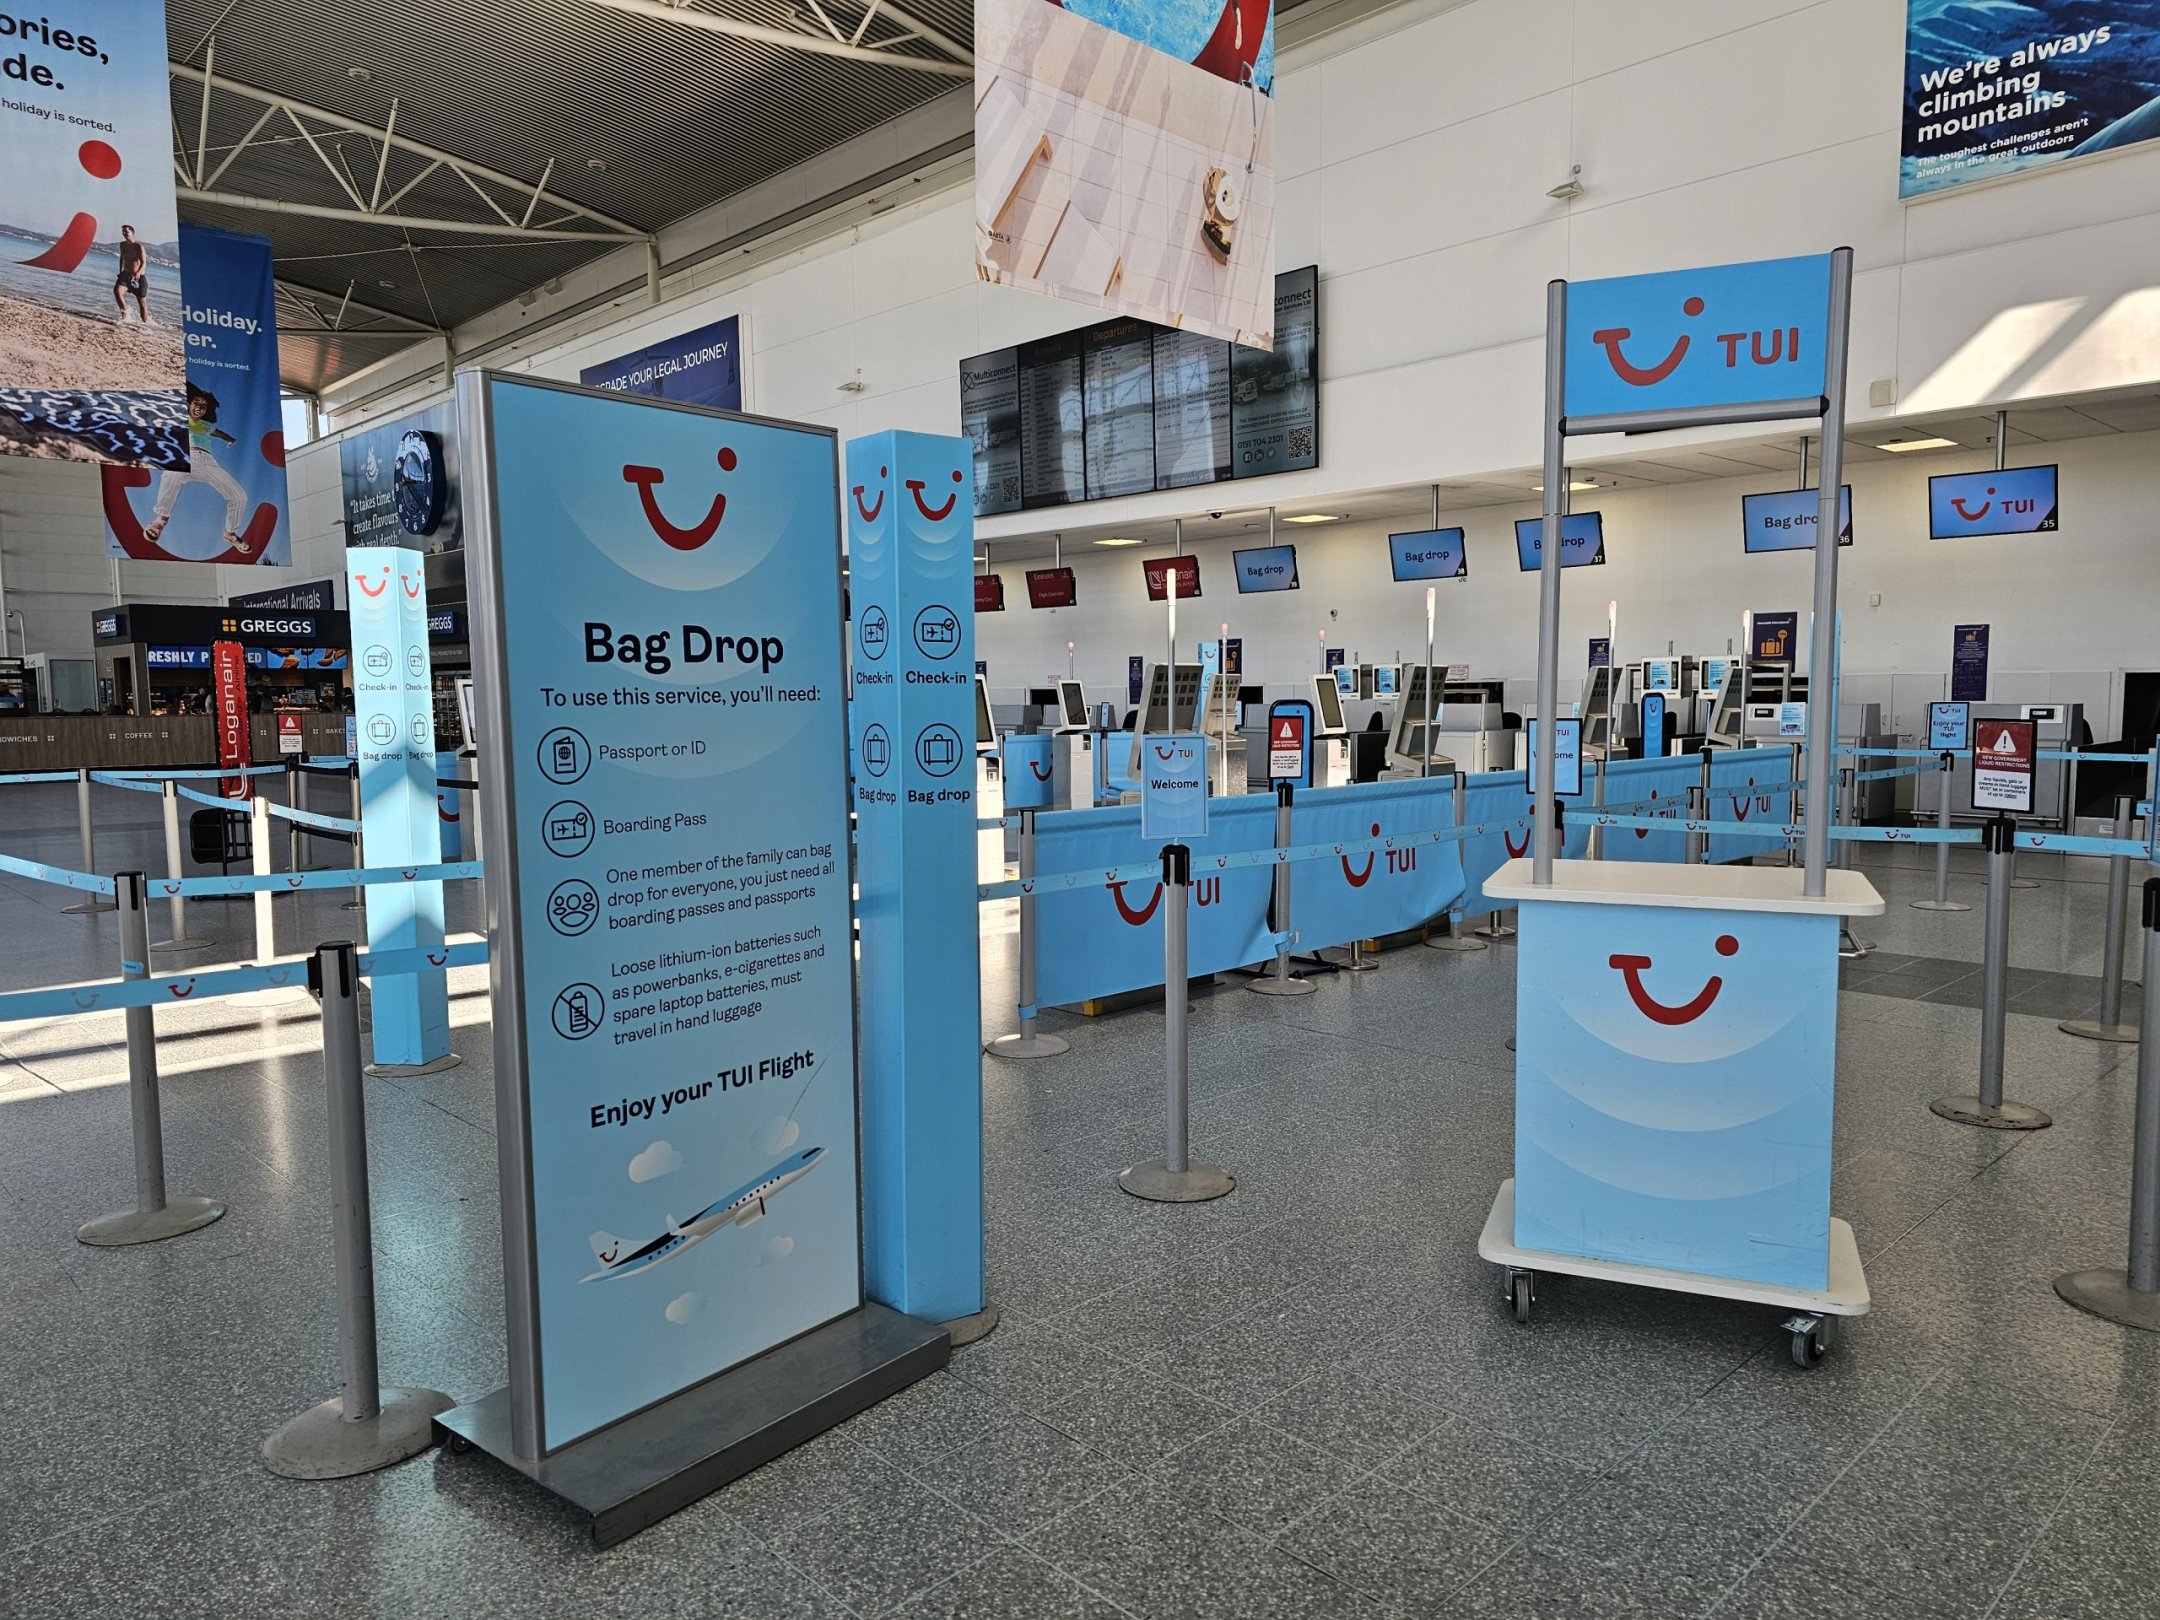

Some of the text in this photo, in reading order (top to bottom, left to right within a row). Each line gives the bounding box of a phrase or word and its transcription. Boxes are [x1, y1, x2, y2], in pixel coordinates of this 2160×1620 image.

[1920, 25, 2111, 93] We’re always
[1918, 71, 2041, 118] climbing
[1, 98, 117, 134] holiday is sorted.
[1917, 90, 2066, 143] mountains
[1917, 117, 2089, 168] The toughest challenges aren’t
[1916, 133, 2075, 179] always in the great outdoors
[182, 305, 262, 335] Holiday.
[1093, 322, 1138, 341] Departures
[1716, 327, 1799, 368] TUI
[188, 357, 216, 368] holiday
[224, 363, 251, 371] sorted.
[628, 341, 728, 387] YOUR LEGAL JOURNEY
[973, 364, 1016, 380] Multiconnect
[360, 491, 390, 511] takes time
[399, 504, 403, 513] 8
[2001, 499, 2035, 514] TUI
[353, 511, 399, 535] create flavours
[413, 522, 418, 531] 6
[1764, 514, 1818, 530] Bag dro
[2042, 519, 2055, 528] 35
[1839, 535, 1850, 543] 36
[1405, 551, 1450, 563] Bag drop
[1247, 565, 1284, 577] Bag drop
[290, 589, 321, 609] Arrivals
[241, 619, 311, 633] GREGGS
[428, 616, 452, 631] GREGGS
[148, 650, 195, 663] RESHLY
[584, 622, 784, 674] Bag Drop
[359, 683, 397, 691] Check-in
[405, 682, 429, 691] Check-in
[856, 671, 893, 684] Check-in
[906, 671, 967, 684] Check-in
[220, 650, 239, 759] Loganair
[541, 685, 821, 708] To use this service, you’ll need:
[363, 752, 403, 761] Bag drop
[420, 751, 433, 759] drop
[599, 740, 706, 764] Passport or ID
[1178, 749, 1193, 758] TUI
[1994, 755, 2027, 763] GOVERNMENT
[1151, 778, 1199, 790] Welcome
[860, 787, 896, 805] Bag drop
[908, 788, 970, 805] Bag drop
[1755, 796, 1771, 813] TUI
[603, 812, 707, 836] Boarding Pass
[606, 843, 832, 884] One member of the family can bag
[1385, 847, 1416, 874] TUI
[607, 861, 835, 911] drop for everyone, you just need all
[608, 885, 816, 931] boarding passes and passports
[611, 926, 821, 978] Loose lithium-ion batteries such
[612, 944, 825, 1000] as powerbanks, e-cigarettes and
[613, 971, 802, 1025] spare laptop batteries, must
[613, 1001, 762, 1046] travel in hand luggage
[590, 1049, 814, 1128] Enjoy your TUI Flight
